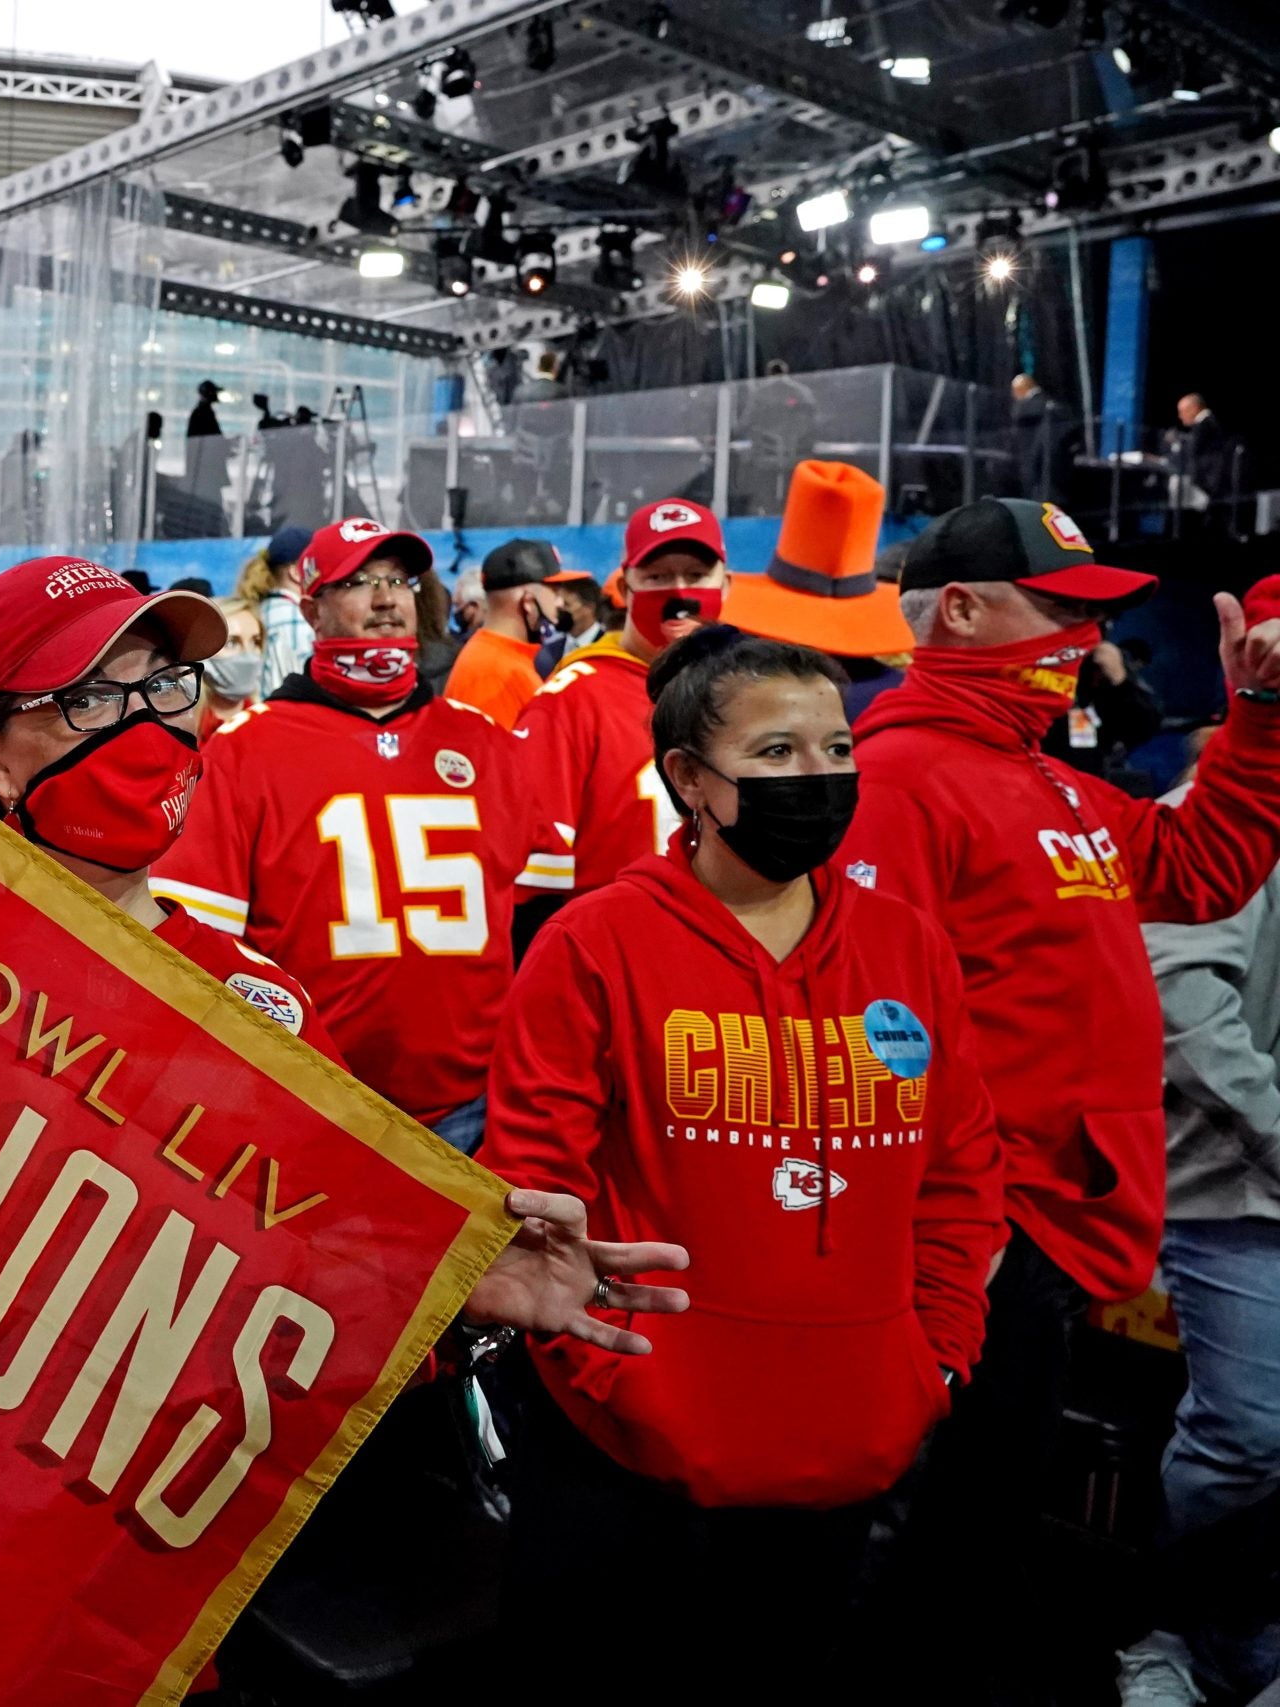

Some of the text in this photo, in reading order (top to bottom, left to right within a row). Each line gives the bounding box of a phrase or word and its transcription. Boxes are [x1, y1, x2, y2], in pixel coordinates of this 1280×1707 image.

[66, 579, 126, 598] FOOTBALL
[73, 826, 104, 839] Mobile
[318, 793, 490, 960] 15
[666, 1124, 791, 1150] COMBINE
[162, 1103, 329, 1229] LIV
